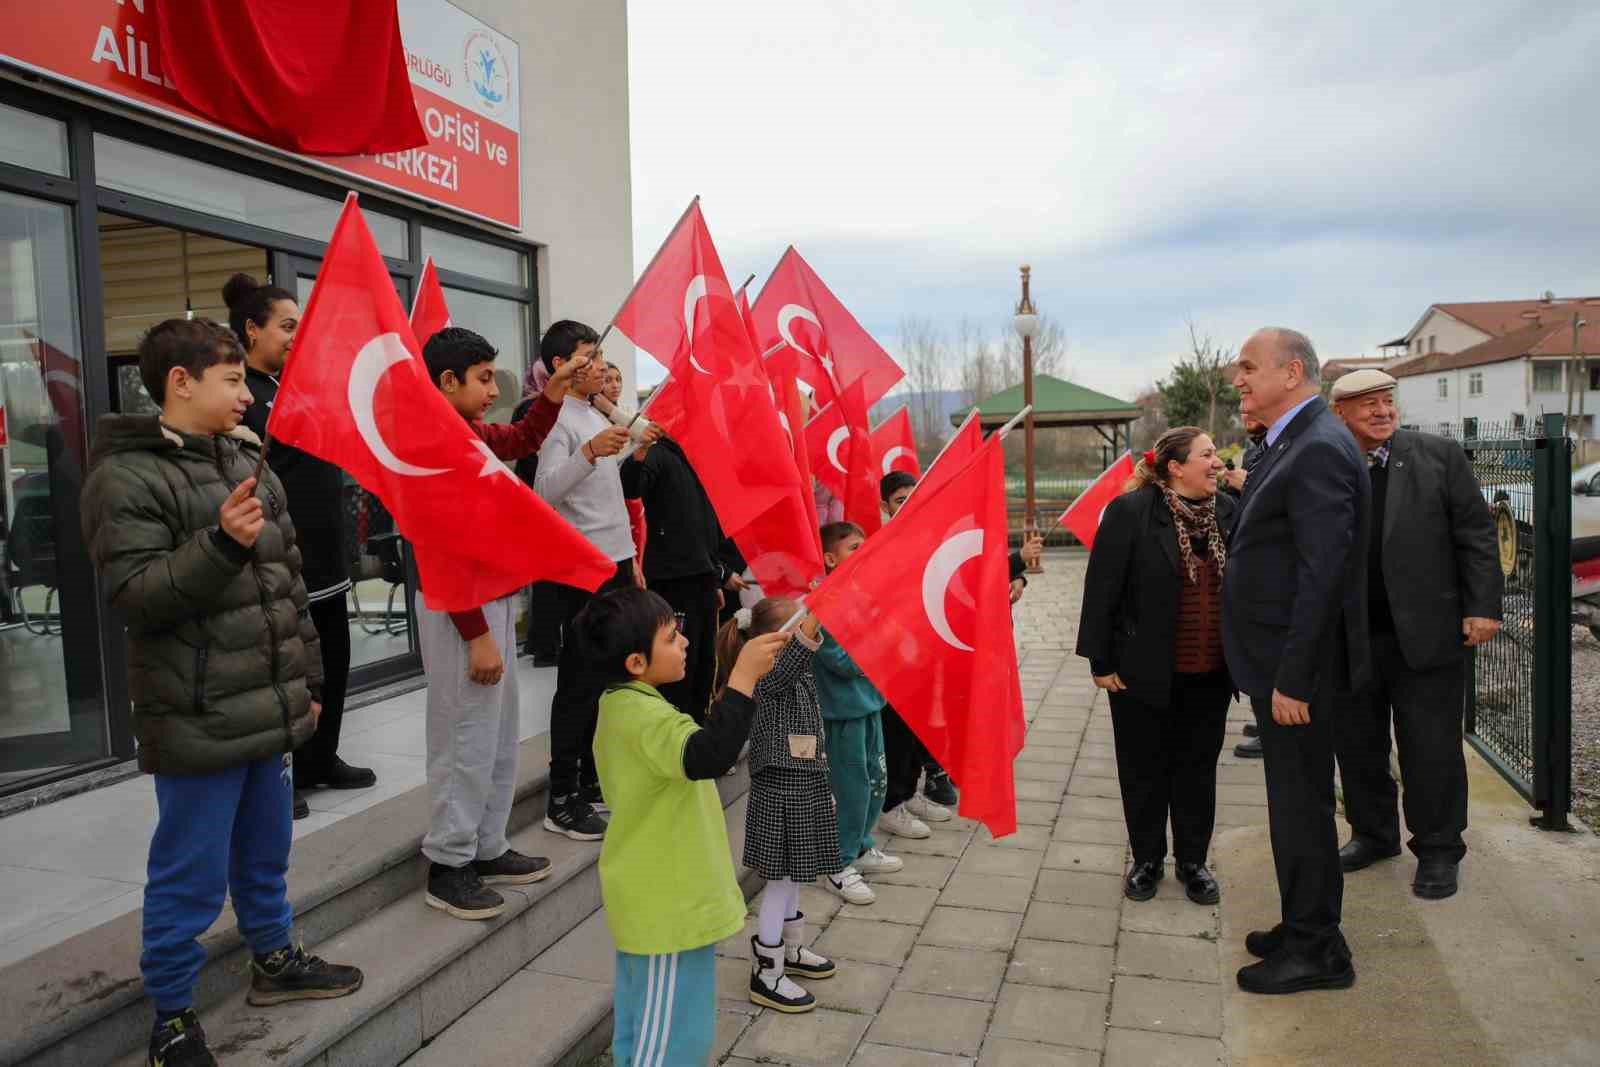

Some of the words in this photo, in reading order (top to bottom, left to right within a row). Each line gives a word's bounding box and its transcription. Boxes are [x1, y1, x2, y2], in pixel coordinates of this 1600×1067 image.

[91, 24, 177, 90] AİL
[407, 50, 451, 88] RLÜĞÜ
[424, 107, 480, 155] OFİSİ
[485, 140, 508, 167] ve
